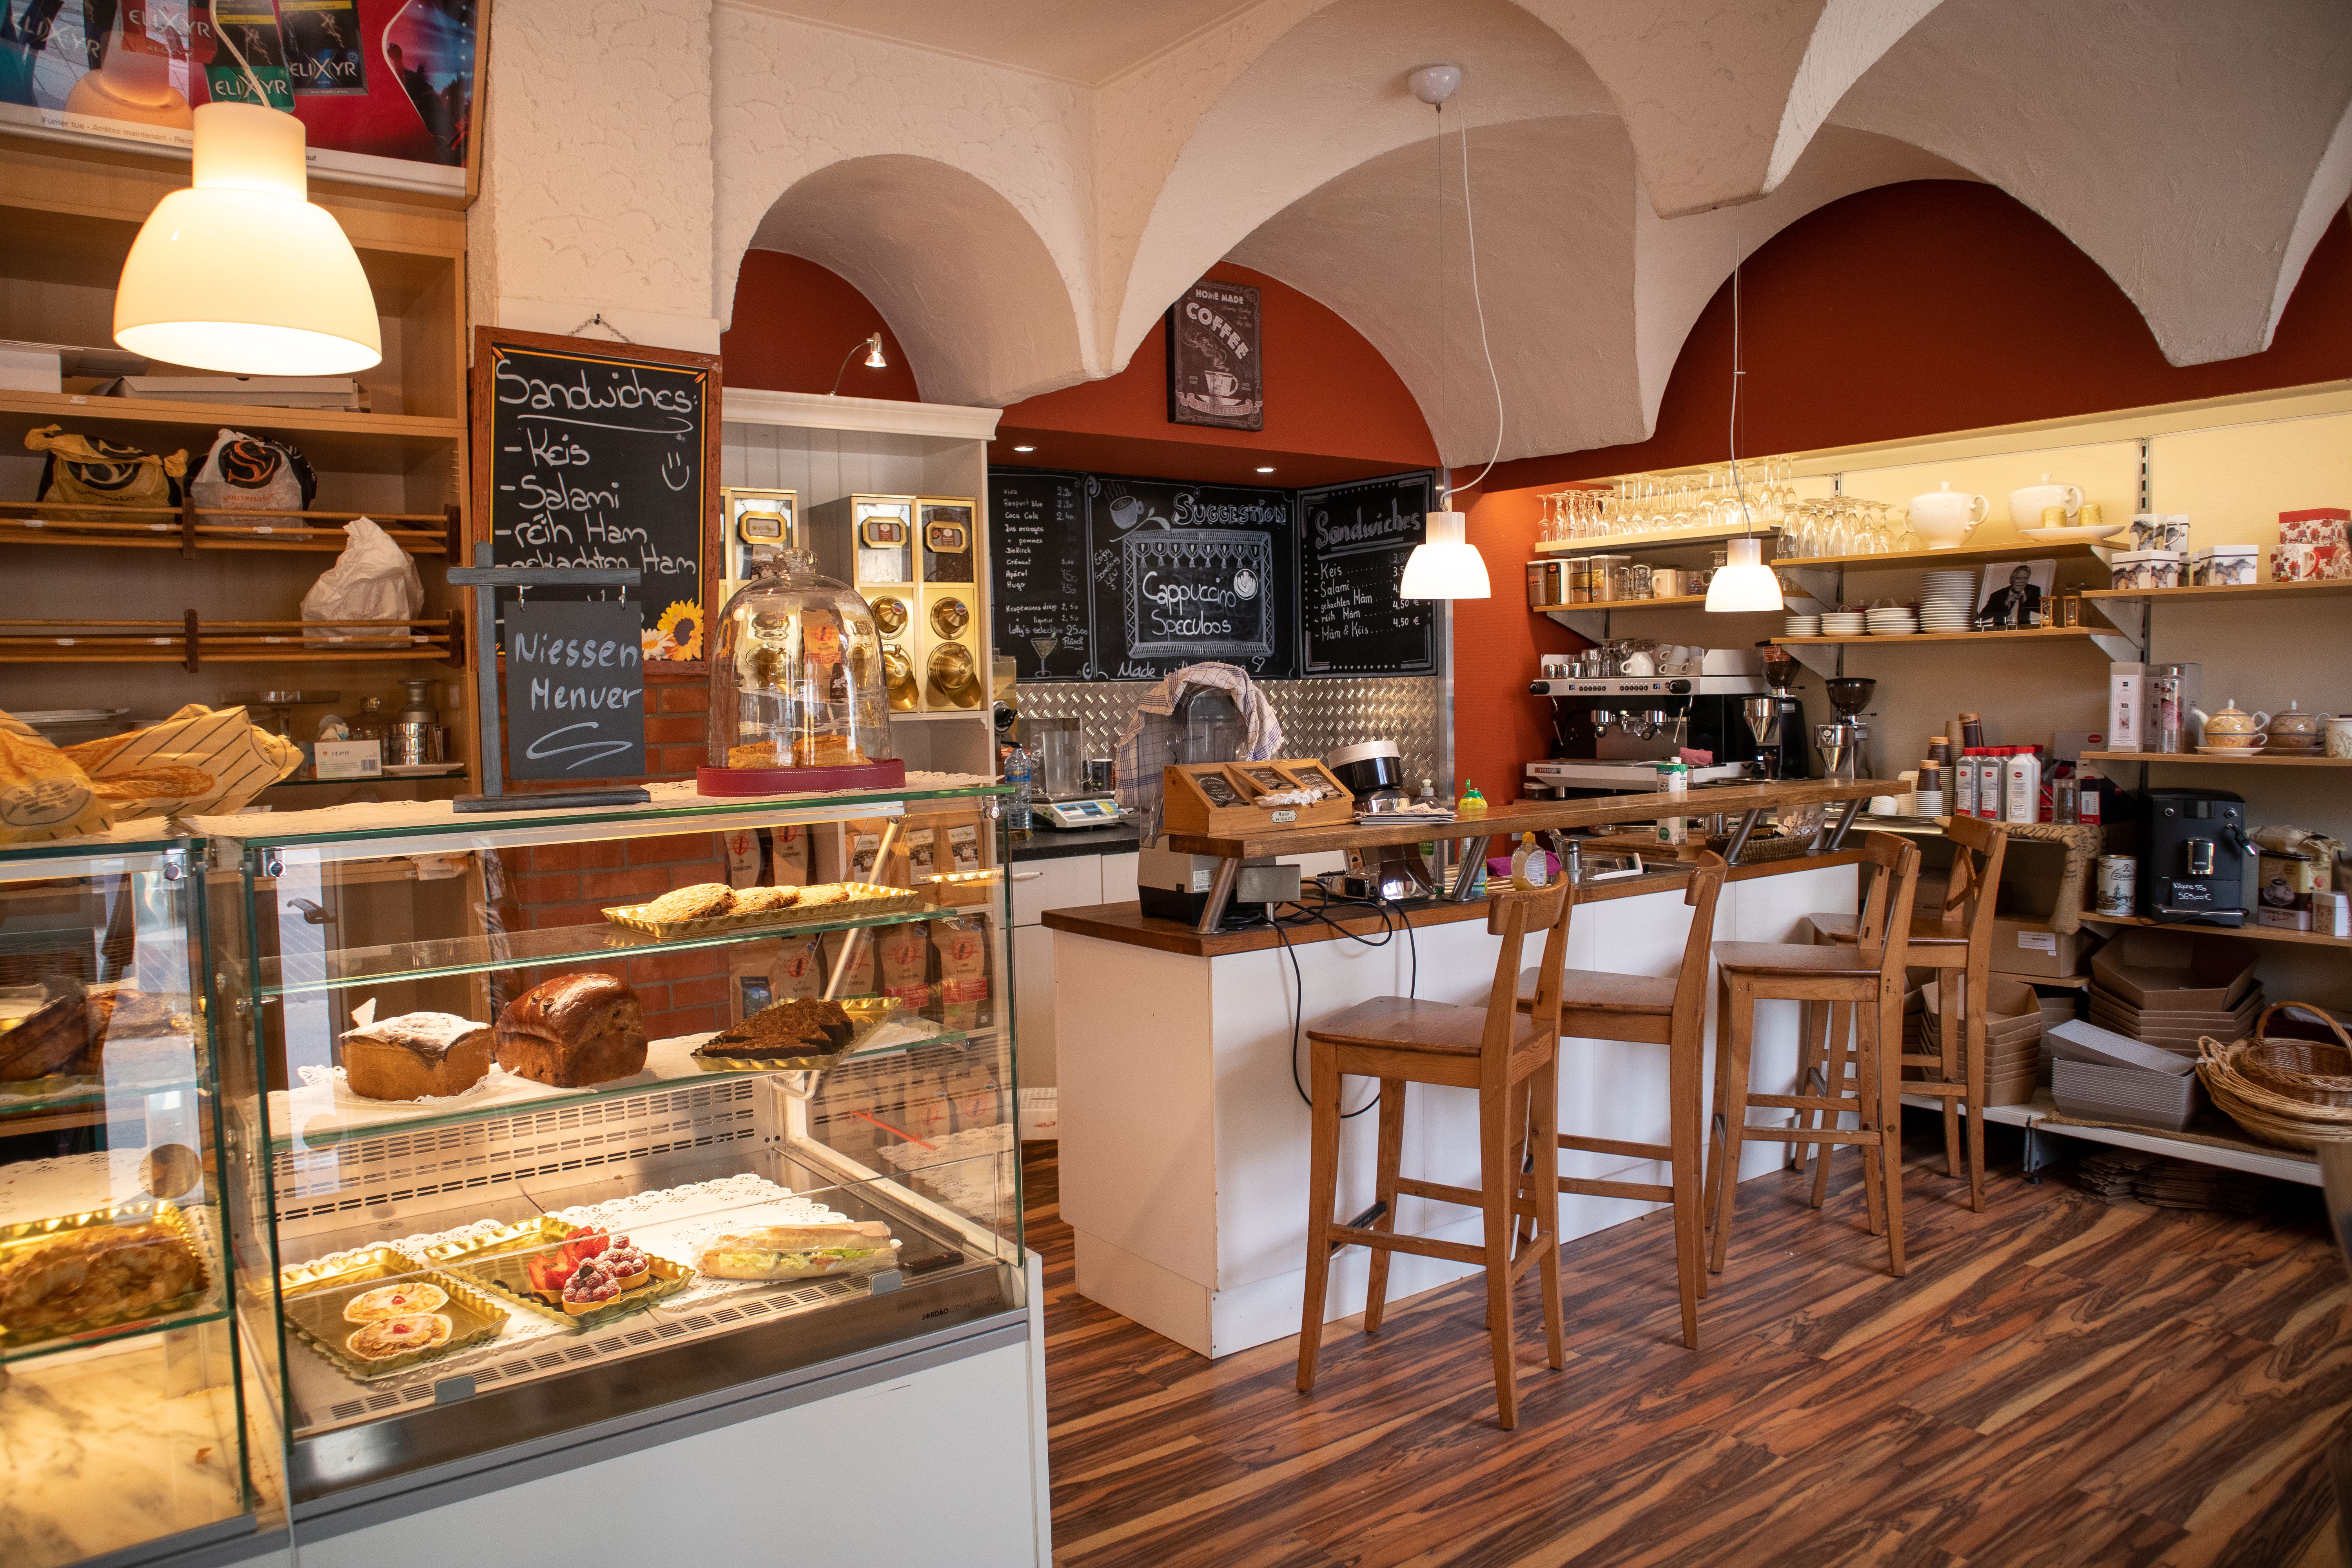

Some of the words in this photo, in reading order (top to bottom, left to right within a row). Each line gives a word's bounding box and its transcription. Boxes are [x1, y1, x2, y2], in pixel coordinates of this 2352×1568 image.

[129, 9, 211, 38] ELIXYR
[290, 57, 357, 79] ELIXYR
[215, 75, 289, 98] ELIXYR
[42, 117, 69, 127] Fumer
[93, 123, 121, 134] Arrêtez
[123, 129, 167, 142] maintenant
[174, 135, 194, 144] Rauc
[1195, 289, 1219, 301] HOME
[1221, 294, 1244, 304] MADE
[1186, 302, 1249, 360] COFFEE
[1196, 402, 1215, 411] MAIN
[519, 472, 619, 512] Salami
[1024, 511, 1039, 519] Cola
[1315, 497, 1421, 550] Sandwiches
[584, 512, 648, 544] Ham
[1018, 526, 1044, 535] oranges
[641, 543, 697, 574] Ham
[1007, 581, 1026, 592] Hugo
[1320, 578, 1350, 597] Salami
[1321, 596, 1350, 613] gekachten
[1343, 624, 1349, 635] &
[515, 632, 638, 668] Niessen
[1117, 660, 1156, 678] Made
